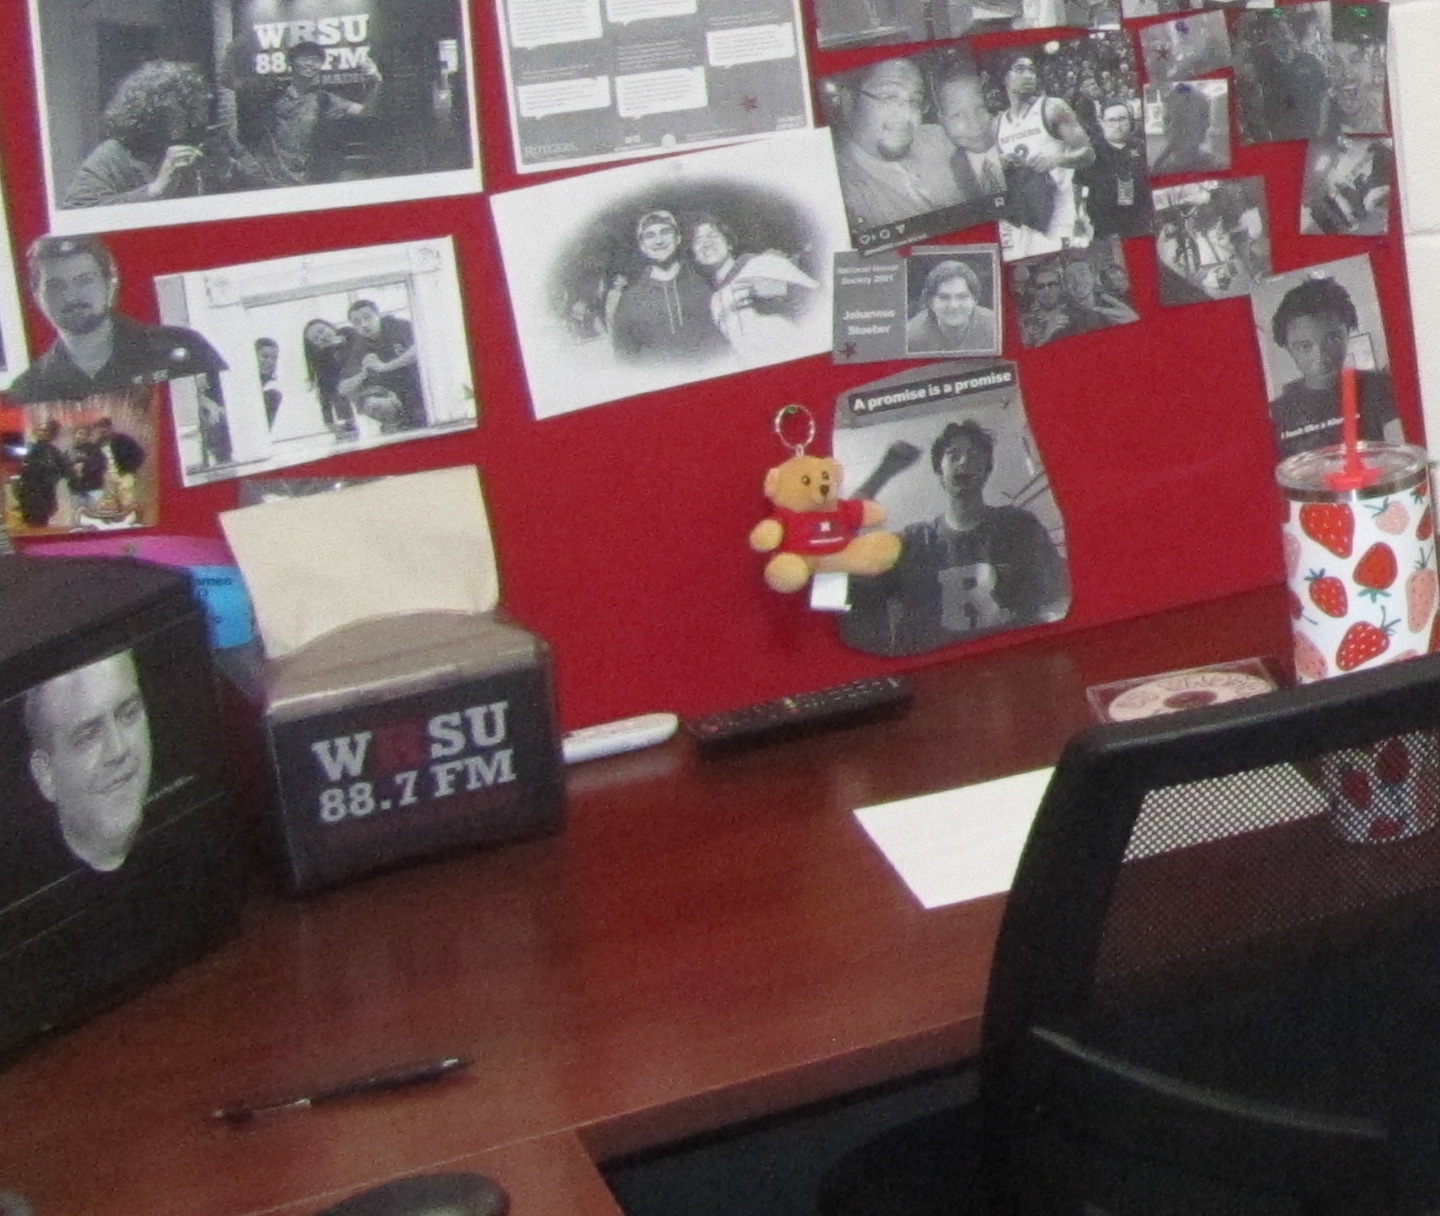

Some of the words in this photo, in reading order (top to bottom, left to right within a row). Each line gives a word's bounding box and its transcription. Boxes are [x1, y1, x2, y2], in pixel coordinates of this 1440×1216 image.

[253, 14, 370, 49] WRSU
[853, 398, 866, 412] A
[867, 387, 926, 411] promise
[929, 383, 941, 396] is
[943, 384, 953, 393] a
[954, 370, 1012, 393] promise
[319, 770, 419, 823] 88.7
[430, 748, 517, 799] FM
